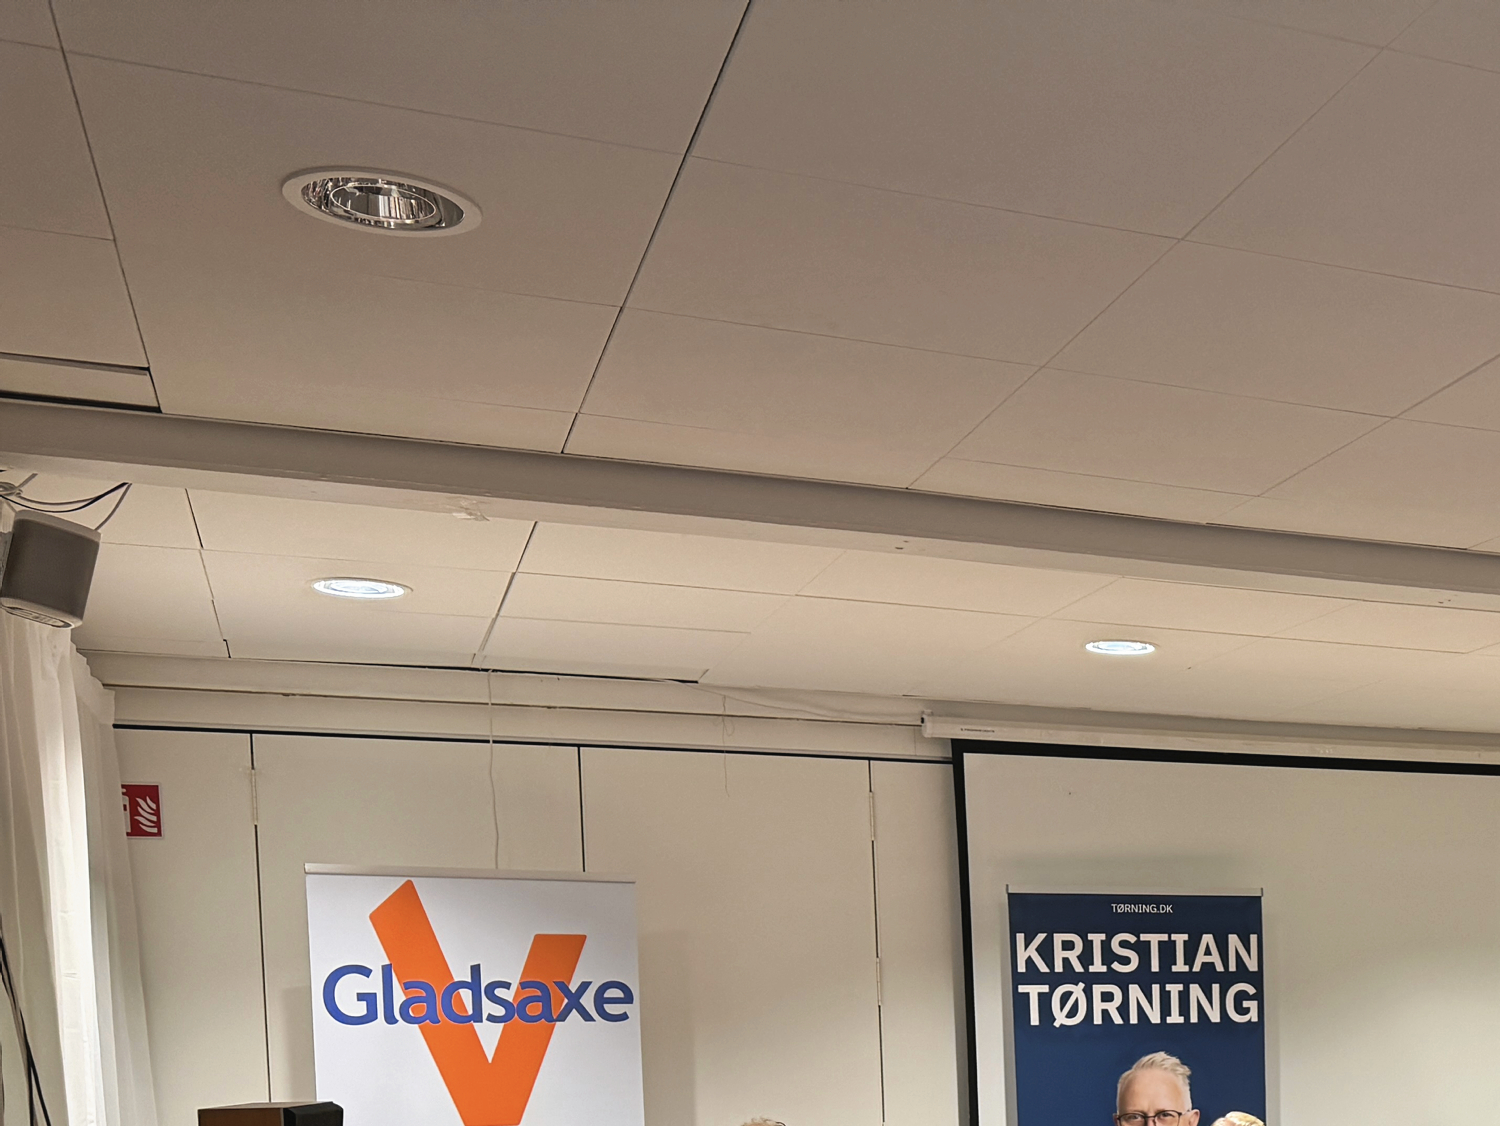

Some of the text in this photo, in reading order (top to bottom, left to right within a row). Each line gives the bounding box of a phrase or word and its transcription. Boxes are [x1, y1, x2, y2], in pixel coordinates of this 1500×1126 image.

[1111, 903, 1173, 914] TØRNING.DK
[1015, 932, 1259, 973] KRISTIAN
[322, 963, 634, 1026] Gladsaxe
[1017, 981, 1259, 1028] TØRNING
